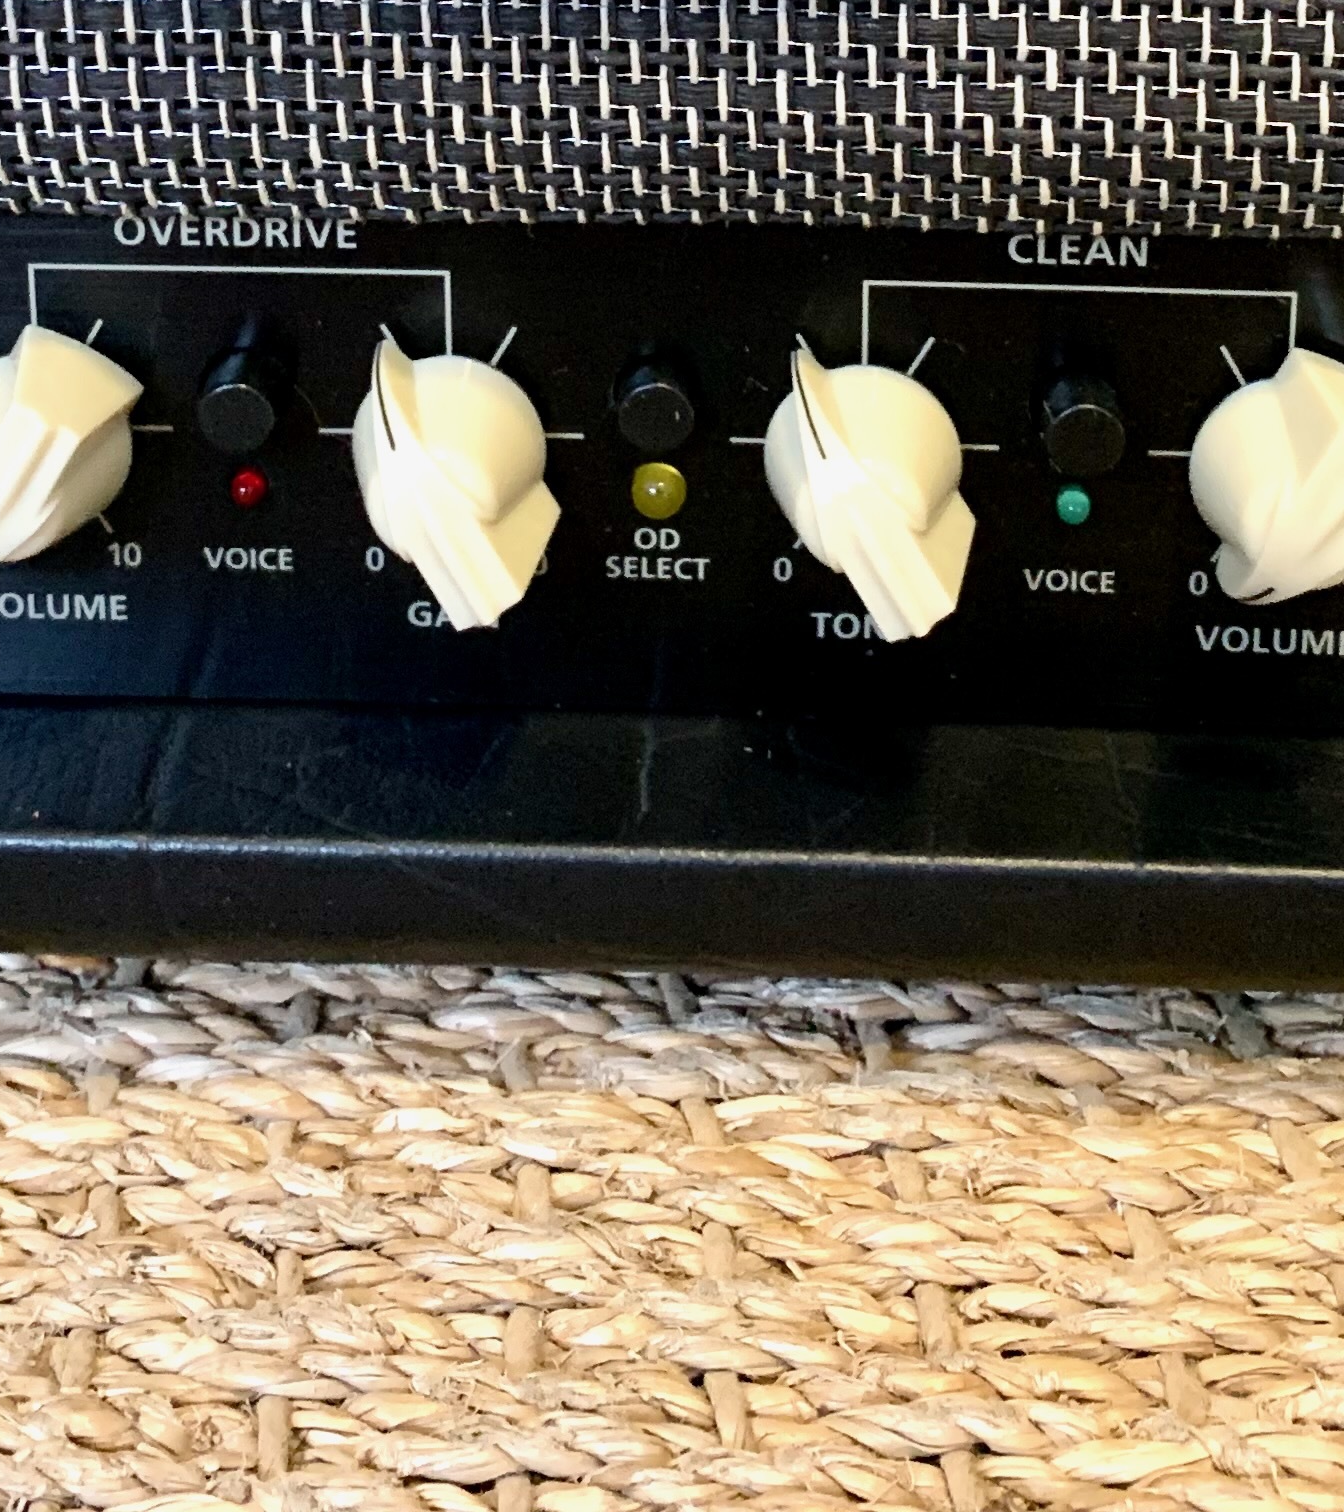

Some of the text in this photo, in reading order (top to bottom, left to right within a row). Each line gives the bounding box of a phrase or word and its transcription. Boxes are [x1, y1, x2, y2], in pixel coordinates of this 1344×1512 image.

[113, 217, 358, 249] OVERDRIVE
[1007, 234, 1149, 267] CLEAN
[633, 527, 681, 550] OD
[109, 541, 142, 568] 10
[203, 546, 294, 572] VOICE
[365, 546, 385, 572] 0
[605, 555, 711, 581] SELECT
[773, 556, 793, 582] 0
[1023, 568, 1116, 595] VOICE
[1188, 570, 1209, 596] 0
